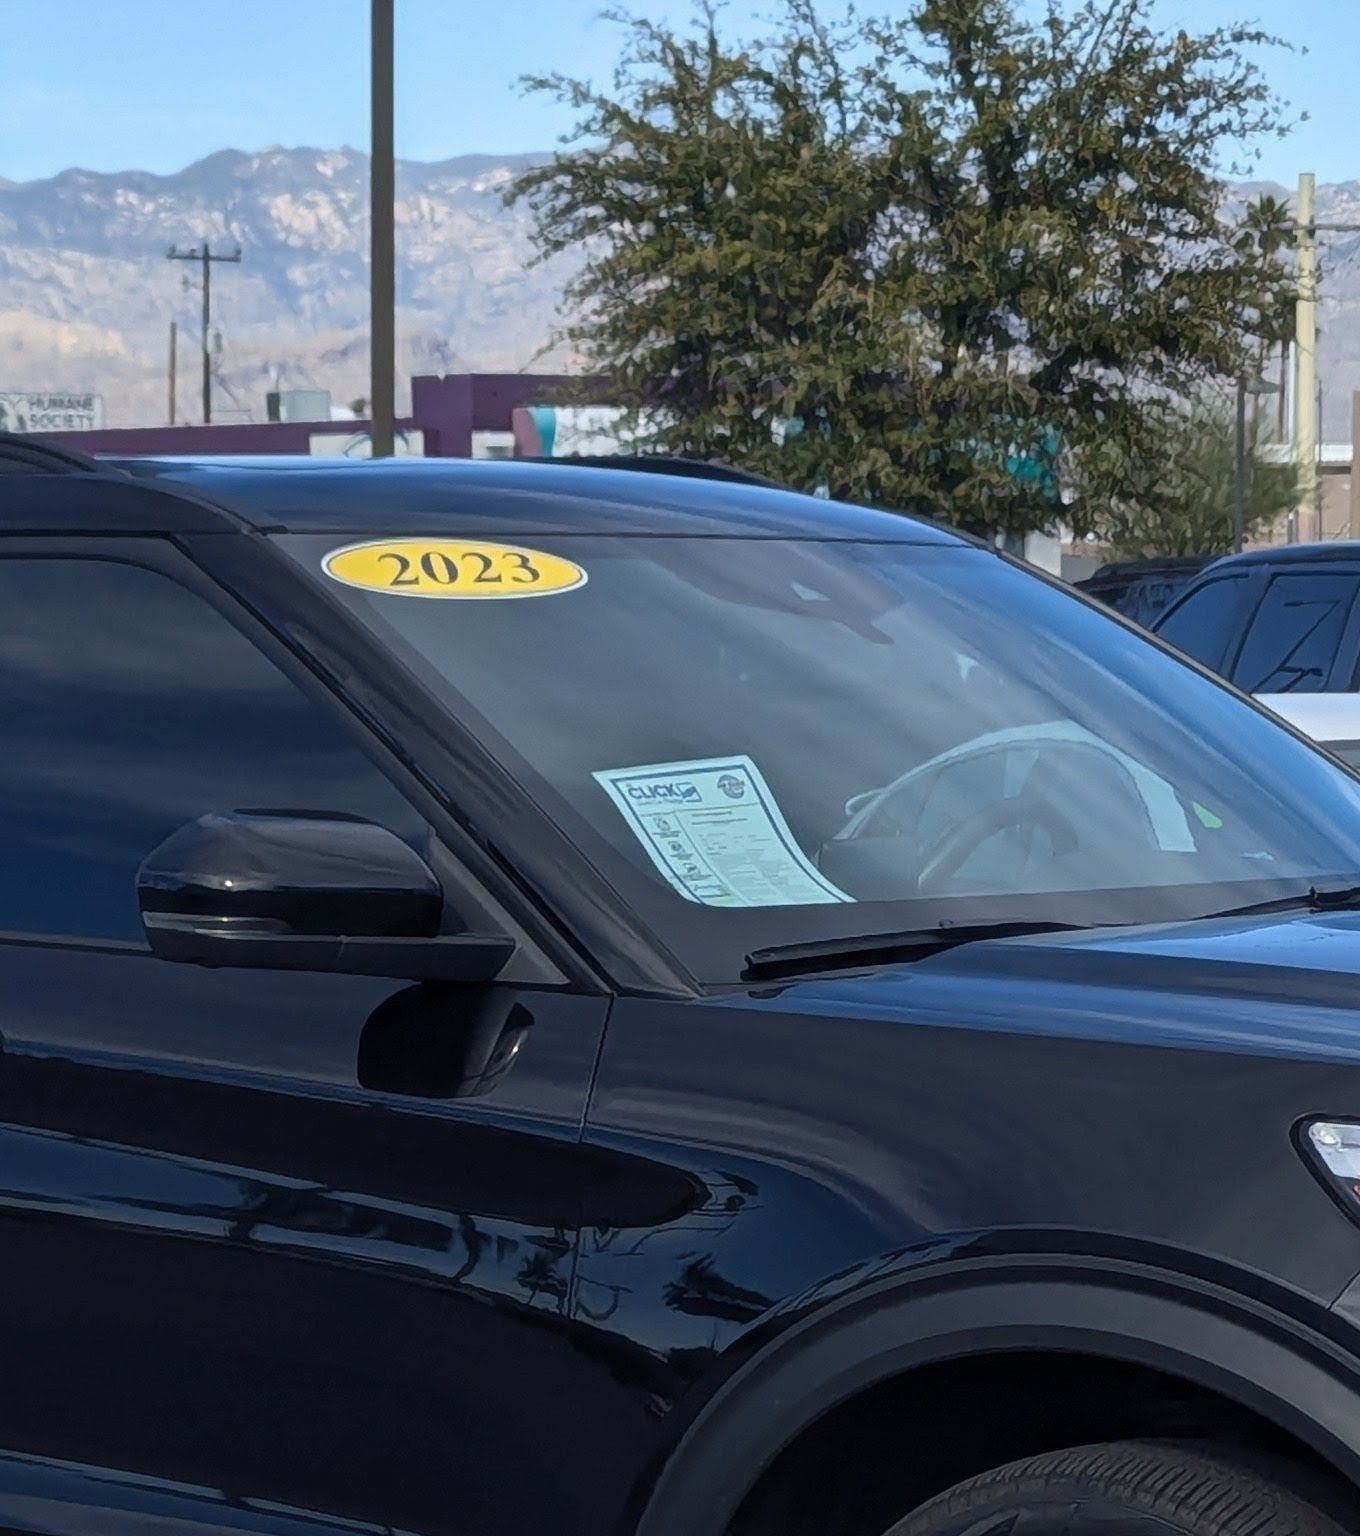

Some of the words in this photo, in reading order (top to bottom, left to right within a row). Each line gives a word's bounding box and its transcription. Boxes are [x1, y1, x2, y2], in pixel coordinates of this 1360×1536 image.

[28, 396, 95, 411] HUMANE
[29, 413, 95, 429] SOCIETY
[376, 550, 541, 587] 2023
[627, 783, 682, 800] CLICK
